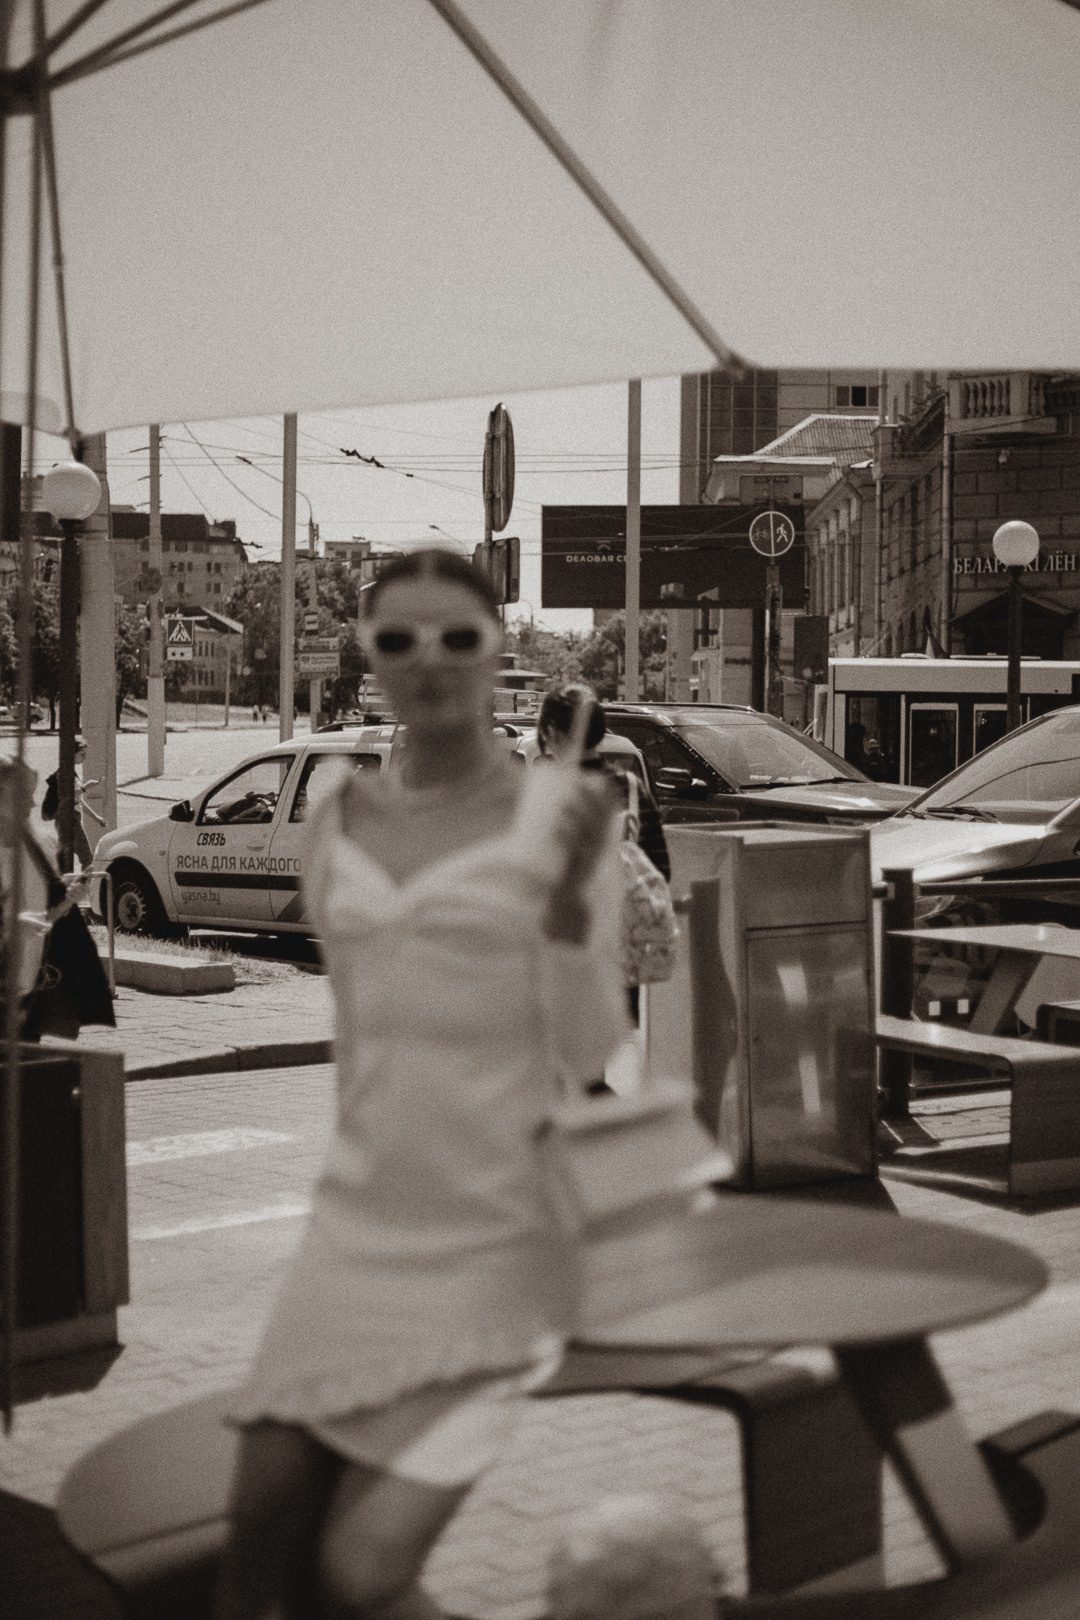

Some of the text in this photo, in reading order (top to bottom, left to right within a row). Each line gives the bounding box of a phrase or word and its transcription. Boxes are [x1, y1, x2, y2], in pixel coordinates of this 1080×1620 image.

[1043, 549, 1076, 572] ЛЁН
[196, 832, 226, 846] СВЯЗЬ
[176, 855, 301, 873] ЯСНА ДЛЯ КАЖДОГО
[181, 889, 220, 905] yasna.by
